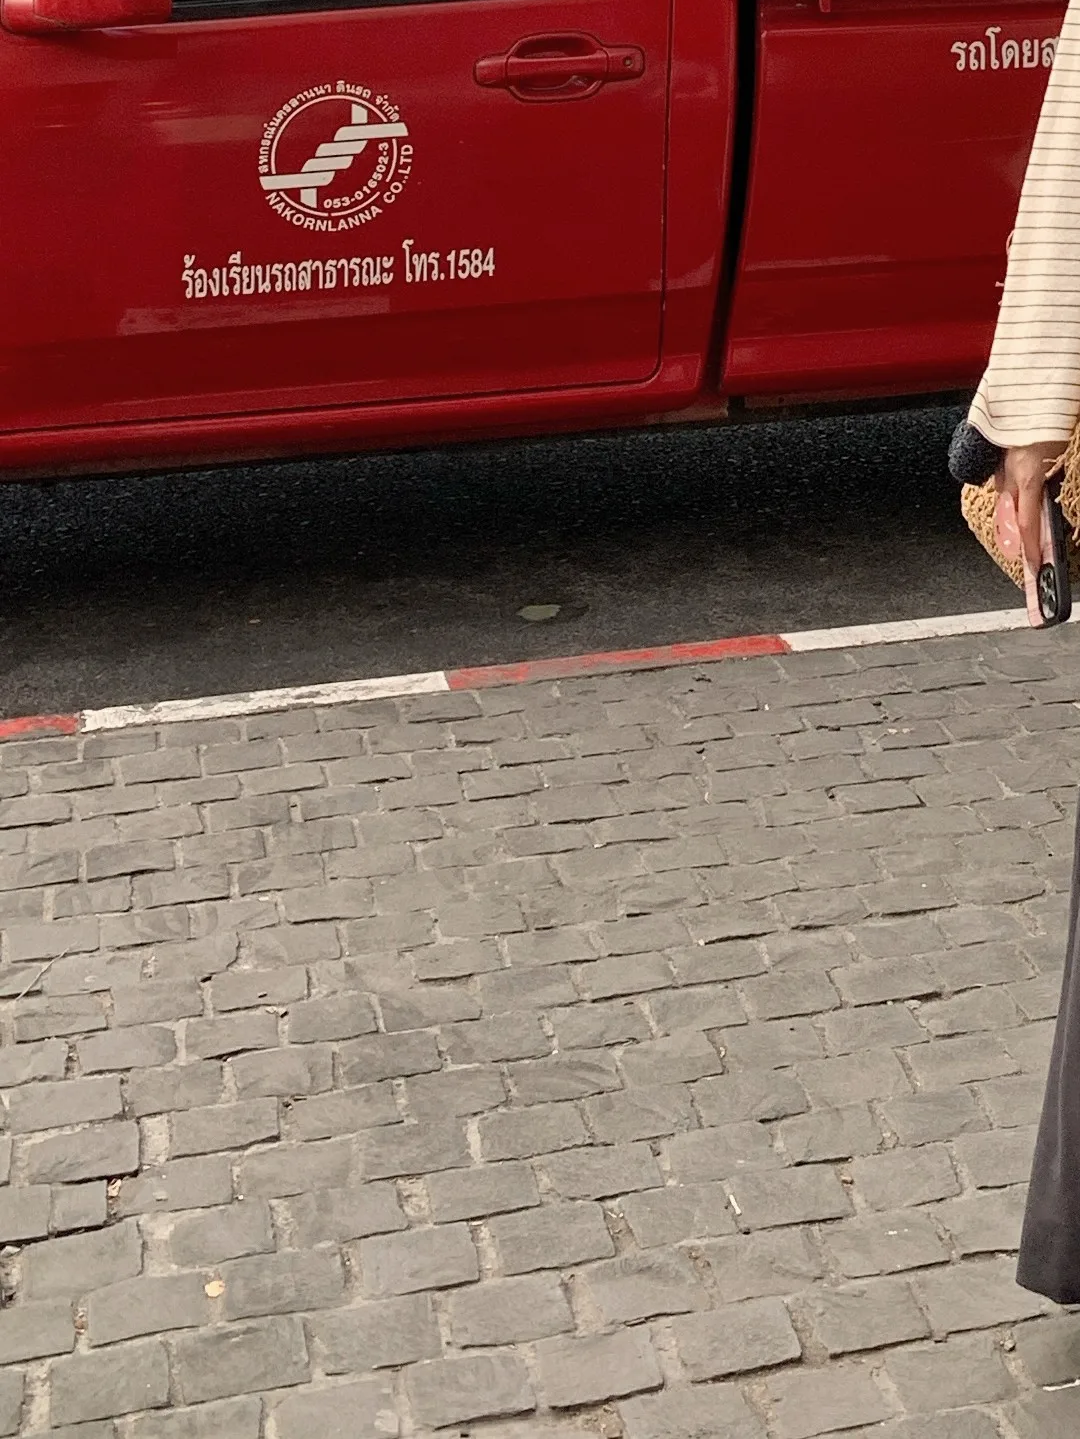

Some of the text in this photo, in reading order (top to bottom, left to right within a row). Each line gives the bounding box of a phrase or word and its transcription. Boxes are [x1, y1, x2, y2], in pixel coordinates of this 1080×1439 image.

[265, 191, 383, 232] NAKORNLANNA
[181, 251, 394, 299] ร้องเรียนรถสาธารณะ
